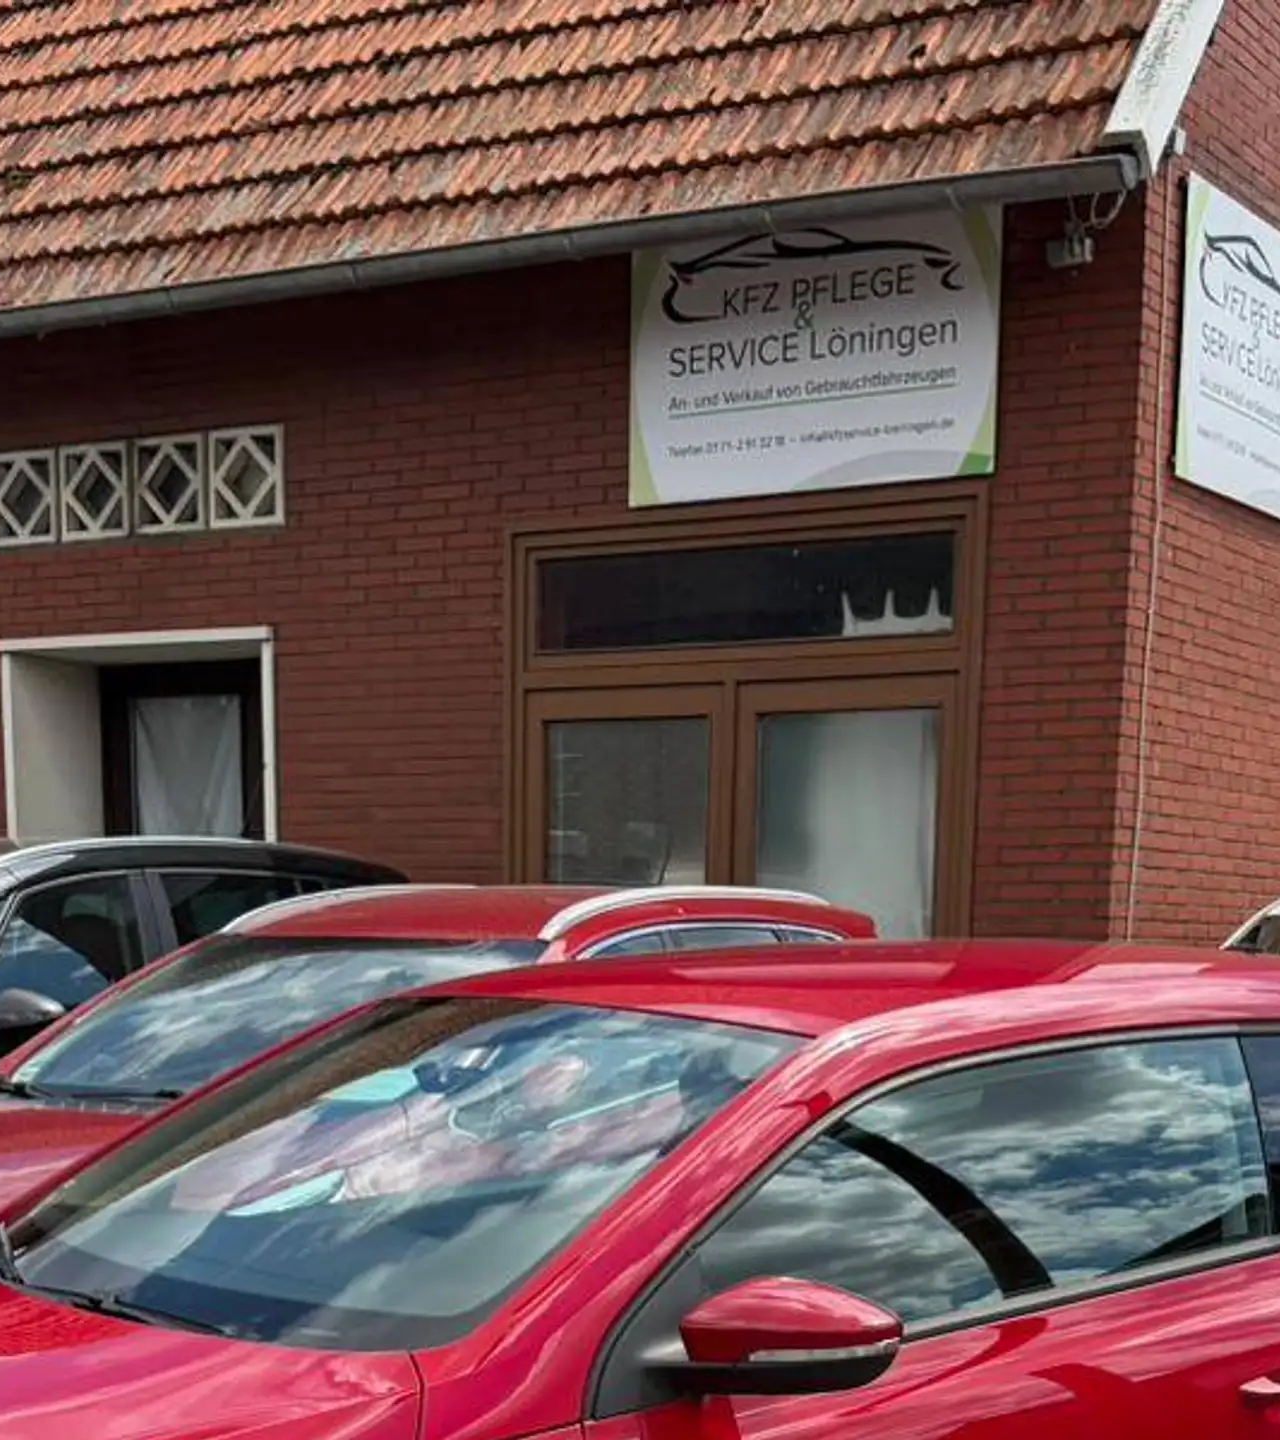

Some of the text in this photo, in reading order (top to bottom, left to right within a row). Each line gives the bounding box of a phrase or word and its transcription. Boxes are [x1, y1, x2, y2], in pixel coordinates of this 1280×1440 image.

[723, 263, 916, 318] KFZ PFLEGE
[793, 299, 815, 330] &
[668, 318, 959, 378] SERVICE Löningen
[668, 395, 691, 412] An-
[776, 382, 803, 400] von
